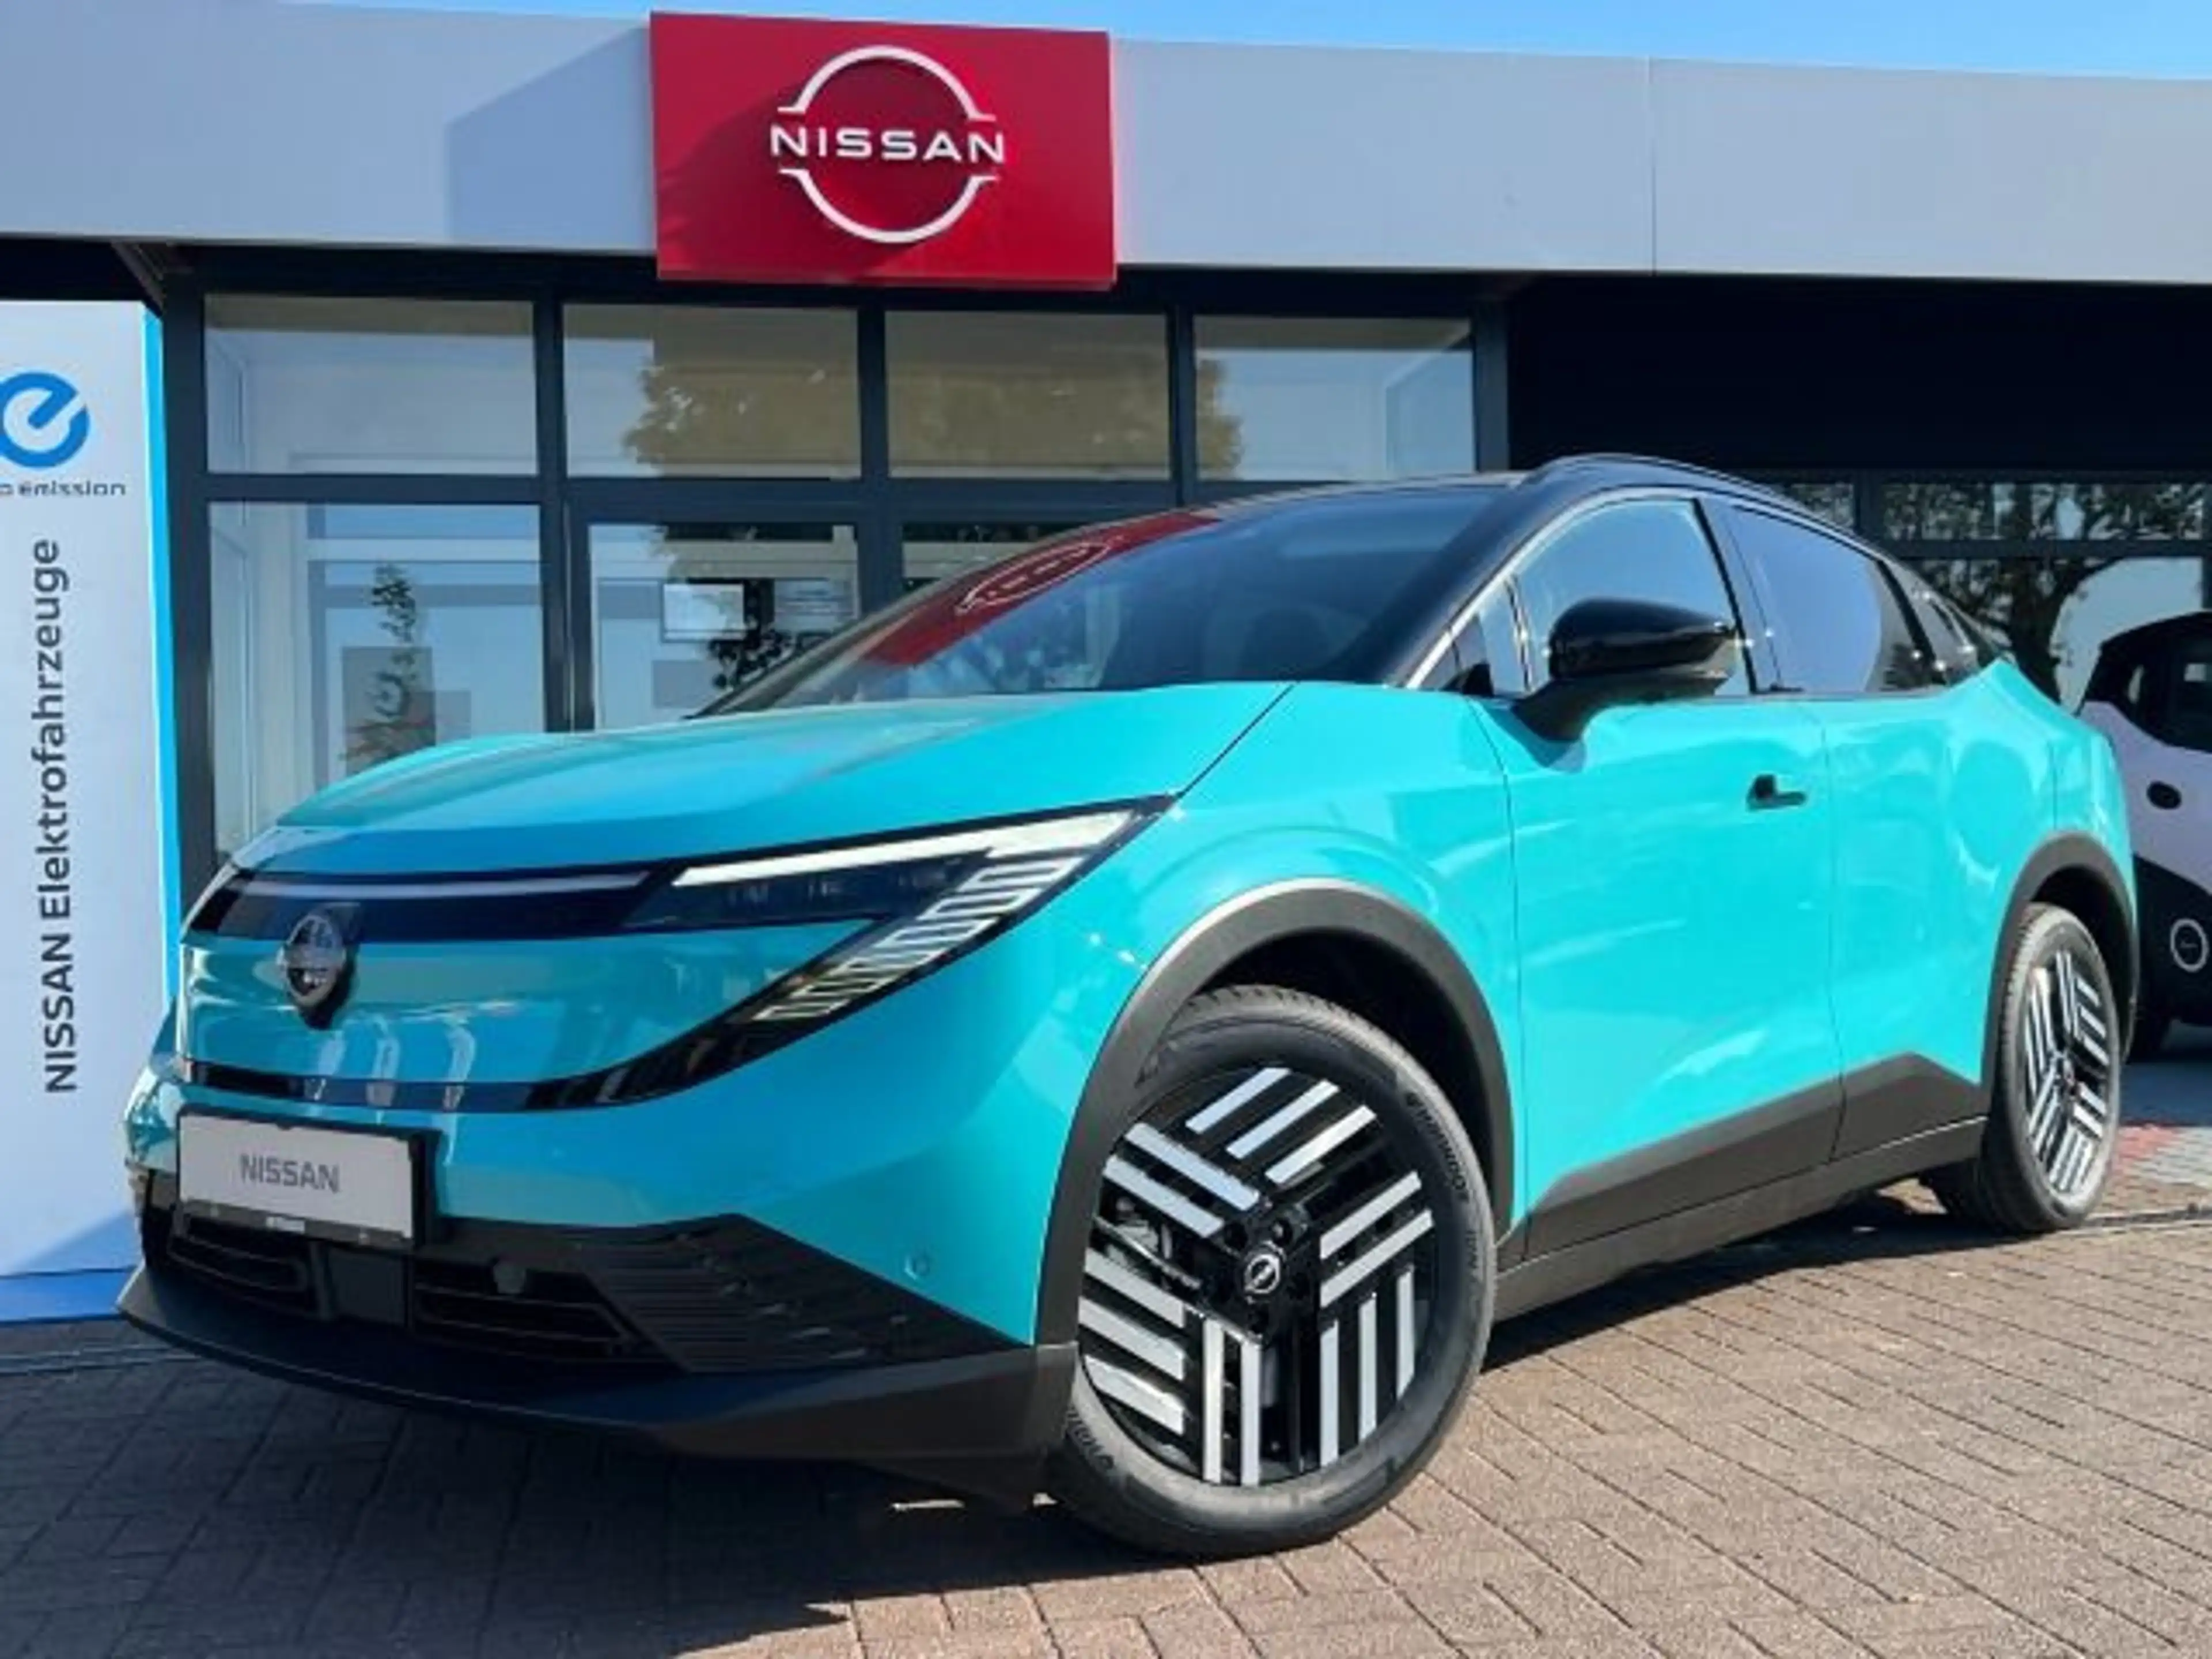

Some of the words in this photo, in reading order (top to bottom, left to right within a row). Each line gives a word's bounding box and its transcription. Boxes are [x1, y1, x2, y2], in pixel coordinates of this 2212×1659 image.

[770, 125, 1005, 164] NISSAN
[19, 480, 126, 495] emission
[30, 539, 71, 921] Elektrofahrzeuge
[40, 933, 77, 1093] NISSAN
[240, 1153, 340, 1194] NISSAN
